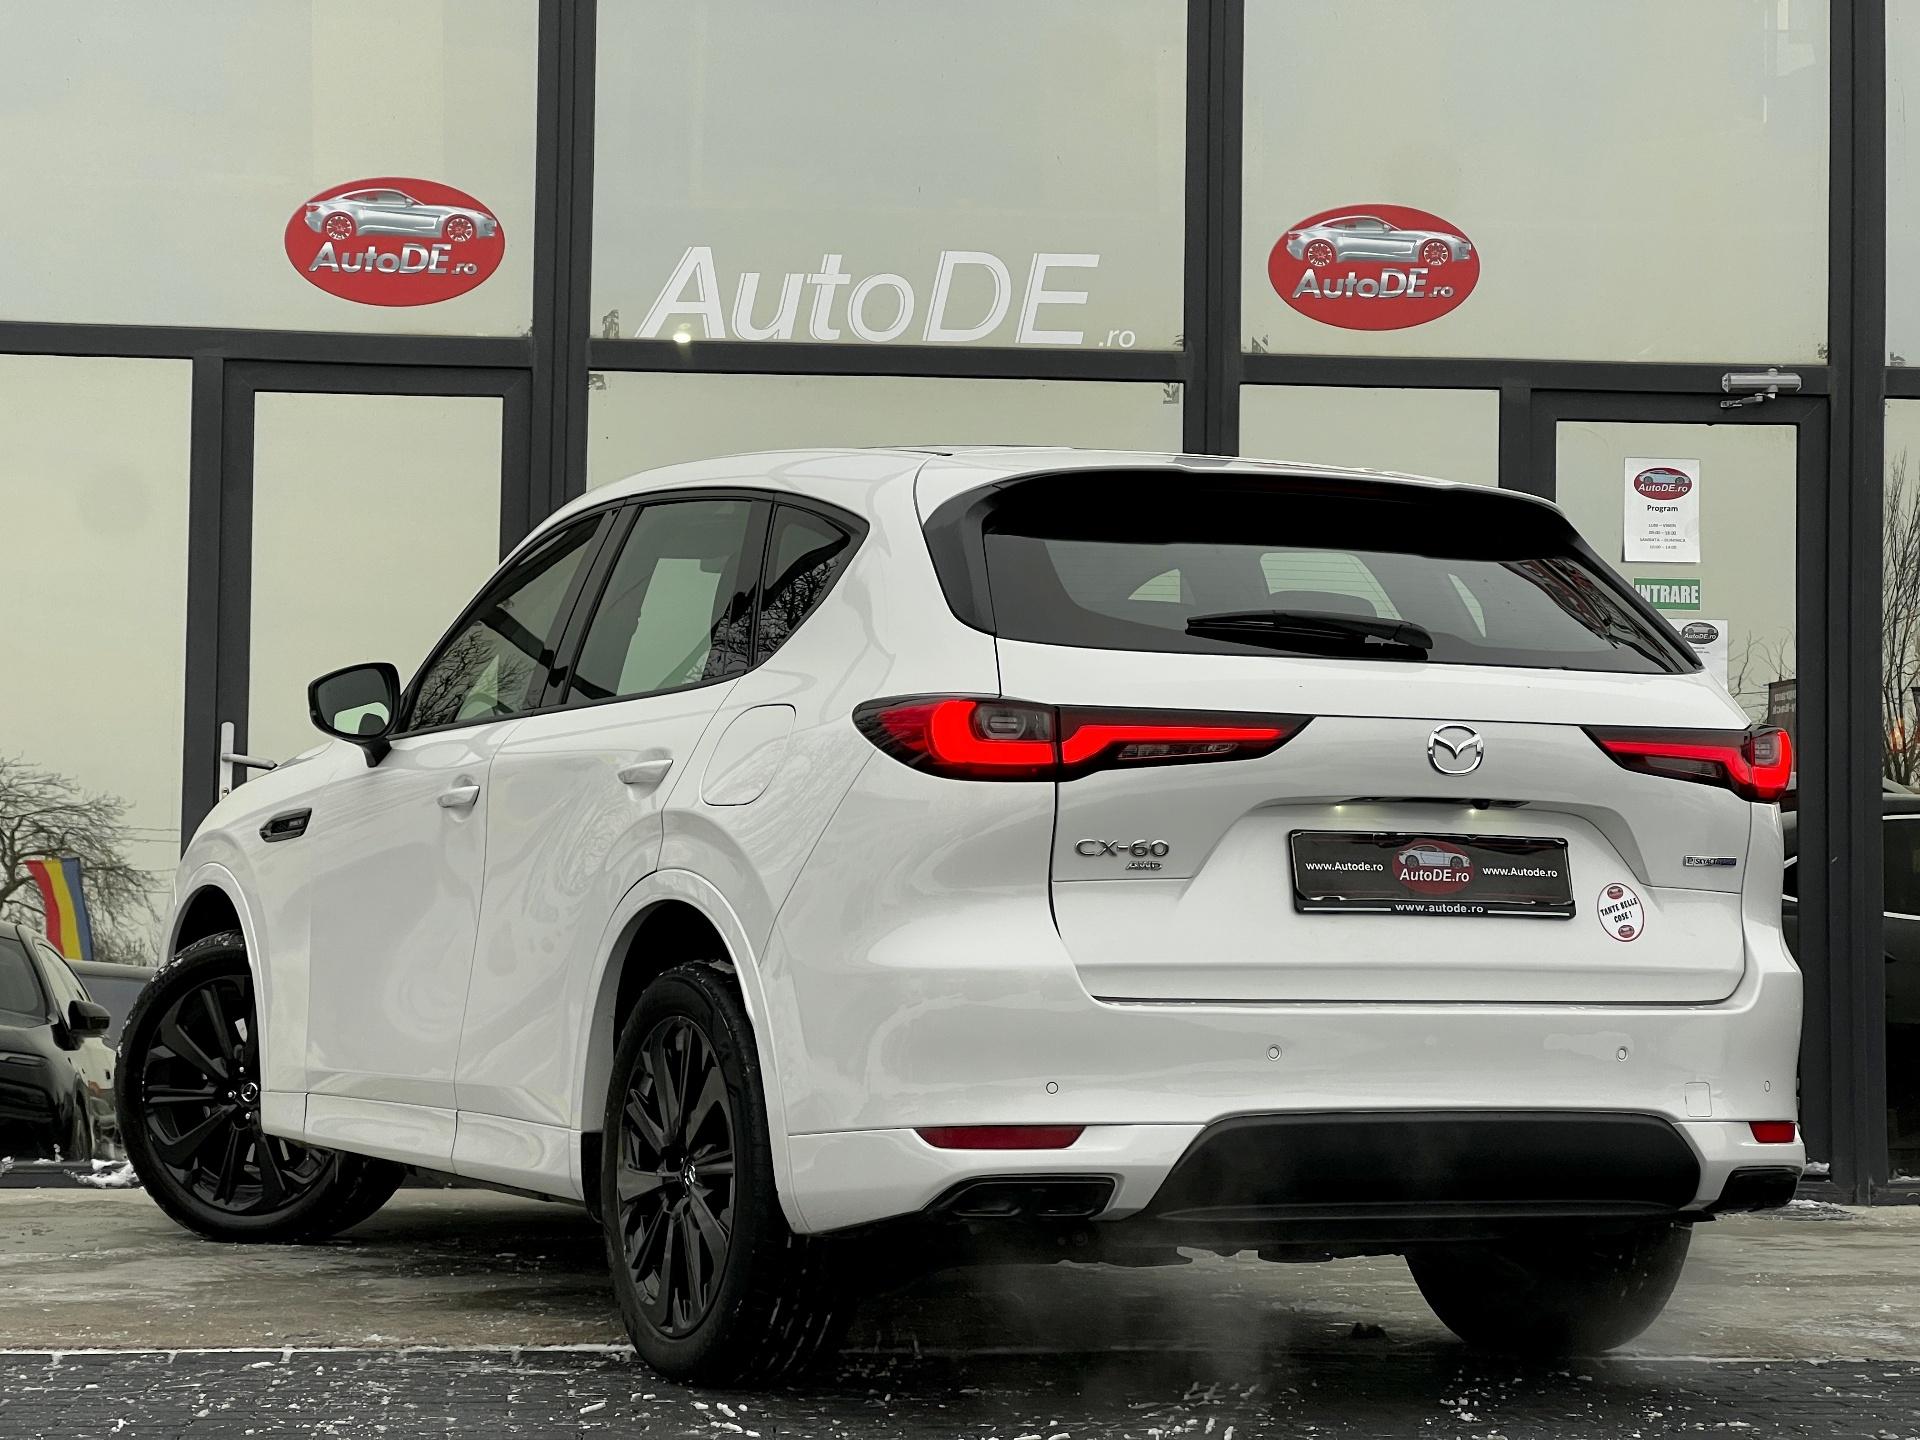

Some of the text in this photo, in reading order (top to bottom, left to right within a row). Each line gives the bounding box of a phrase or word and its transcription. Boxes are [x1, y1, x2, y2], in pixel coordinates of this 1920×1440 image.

[1647, 505, 1678, 513] Program
[1075, 838, 1170, 857] CX-60
[1125, 861, 1162, 871] AWD
[1305, 861, 1384, 872] www.Autode.ro
[1482, 866, 1558, 878] www.Autode.ro
[1399, 868, 1470, 883] AutoDE.ro
[1395, 902, 1484, 914] www.autode.ro
[1600, 897, 1638, 917] TANTE BELLE
